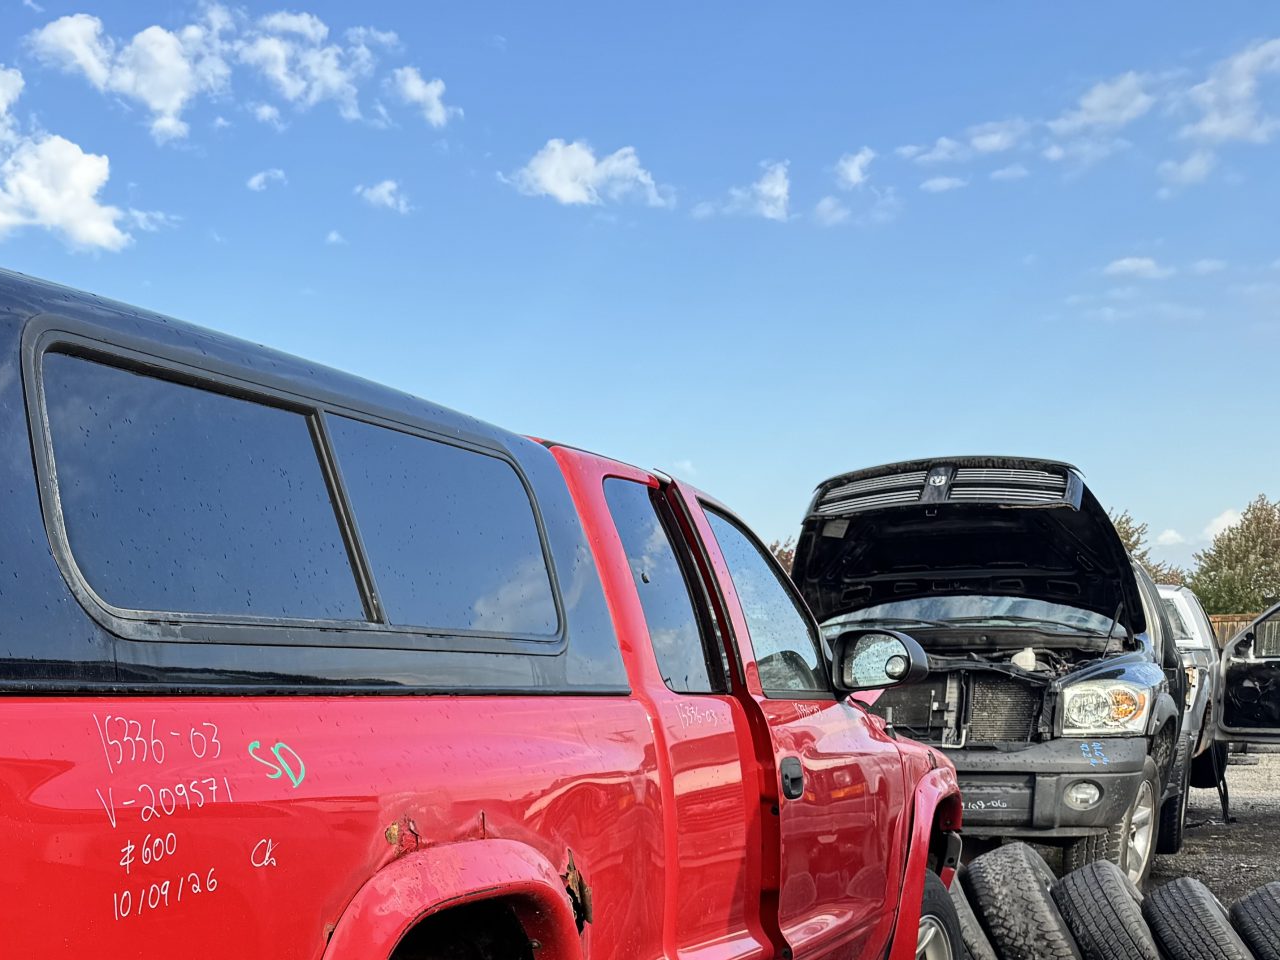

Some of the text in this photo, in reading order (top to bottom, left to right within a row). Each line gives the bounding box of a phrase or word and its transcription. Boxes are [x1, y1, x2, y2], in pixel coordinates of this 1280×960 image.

[92, 713, 221, 774] 15336-03
[247, 740, 306, 788] SD
[95, 776, 234, 828] V-209571
